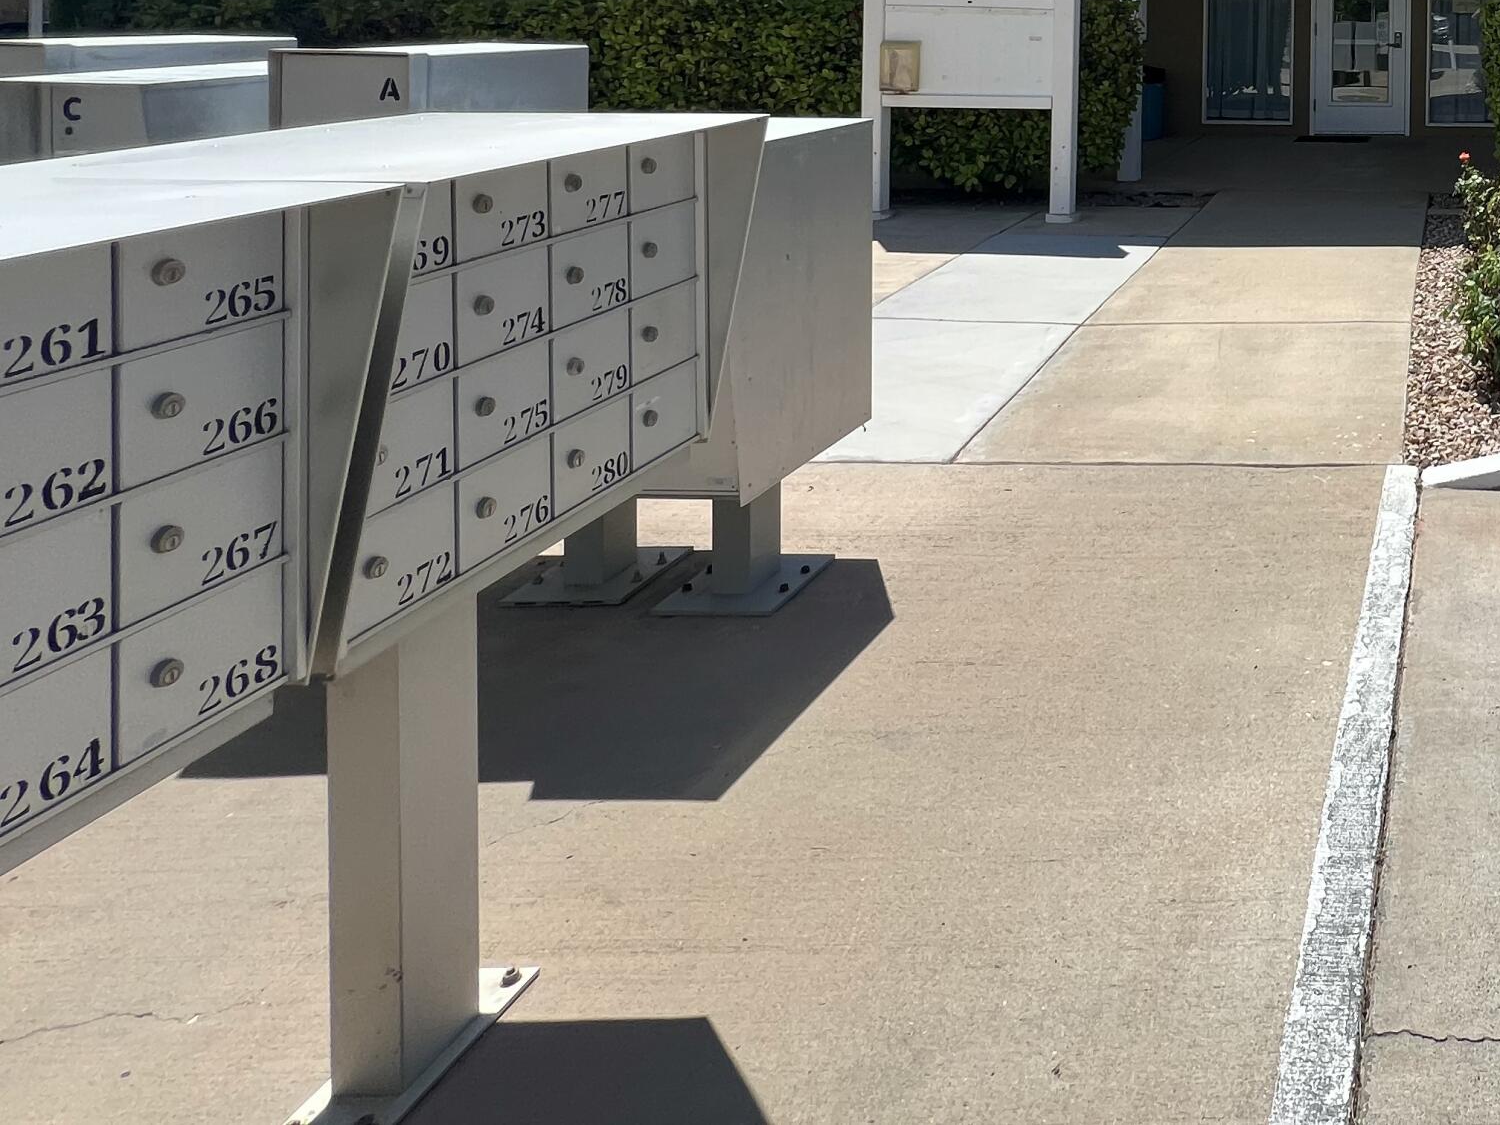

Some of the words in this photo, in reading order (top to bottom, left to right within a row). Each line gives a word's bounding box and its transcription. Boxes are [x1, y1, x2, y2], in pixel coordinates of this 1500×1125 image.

[63, 96, 81, 121] C
[379, 77, 400, 102] A
[501, 210, 546, 246] 273
[586, 191, 626, 223] 277
[413, 236, 450, 271] 69
[204, 276, 276, 326] 265
[591, 278, 627, 313] 278
[2, 317, 106, 377] 261
[502, 307, 546, 346] 274
[391, 342, 450, 391] 270
[591, 364, 628, 401] 279
[202, 398, 279, 456] 266
[503, 399, 548, 445] 275
[3, 458, 107, 529] 262
[394, 447, 452, 499] 271
[591, 450, 629, 492] 280
[504, 494, 550, 544] 276
[201, 521, 278, 587] 267
[397, 551, 452, 605] 272
[12, 597, 106, 673] 263
[198, 644, 279, 716] 268
[0, 738, 105, 827] 264
